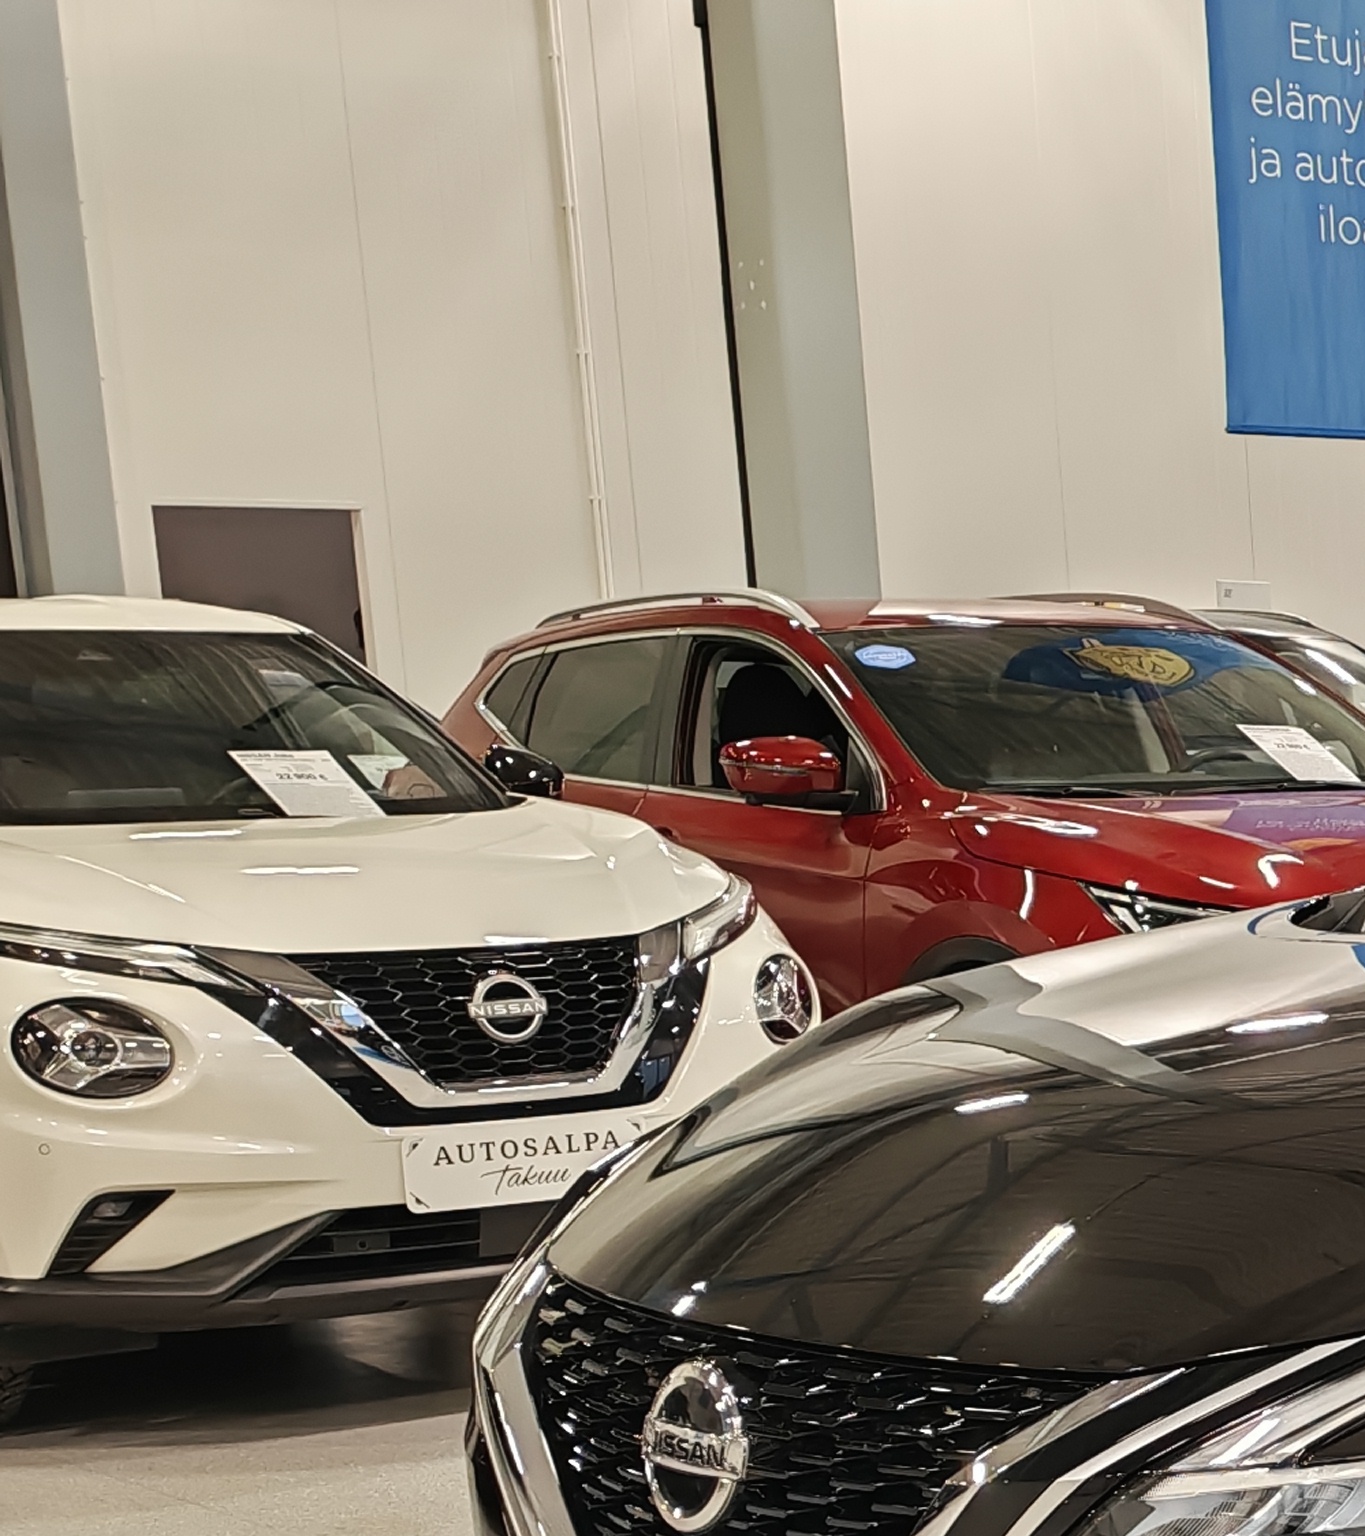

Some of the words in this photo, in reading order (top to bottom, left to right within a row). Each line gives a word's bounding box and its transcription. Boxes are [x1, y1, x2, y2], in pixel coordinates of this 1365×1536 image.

[1249, 136, 1282, 184] ja
[471, 1001, 546, 1017] NISSAN
[433, 1130, 621, 1166] AUTOSALPA
[480, 1164, 572, 1196] Takuu
